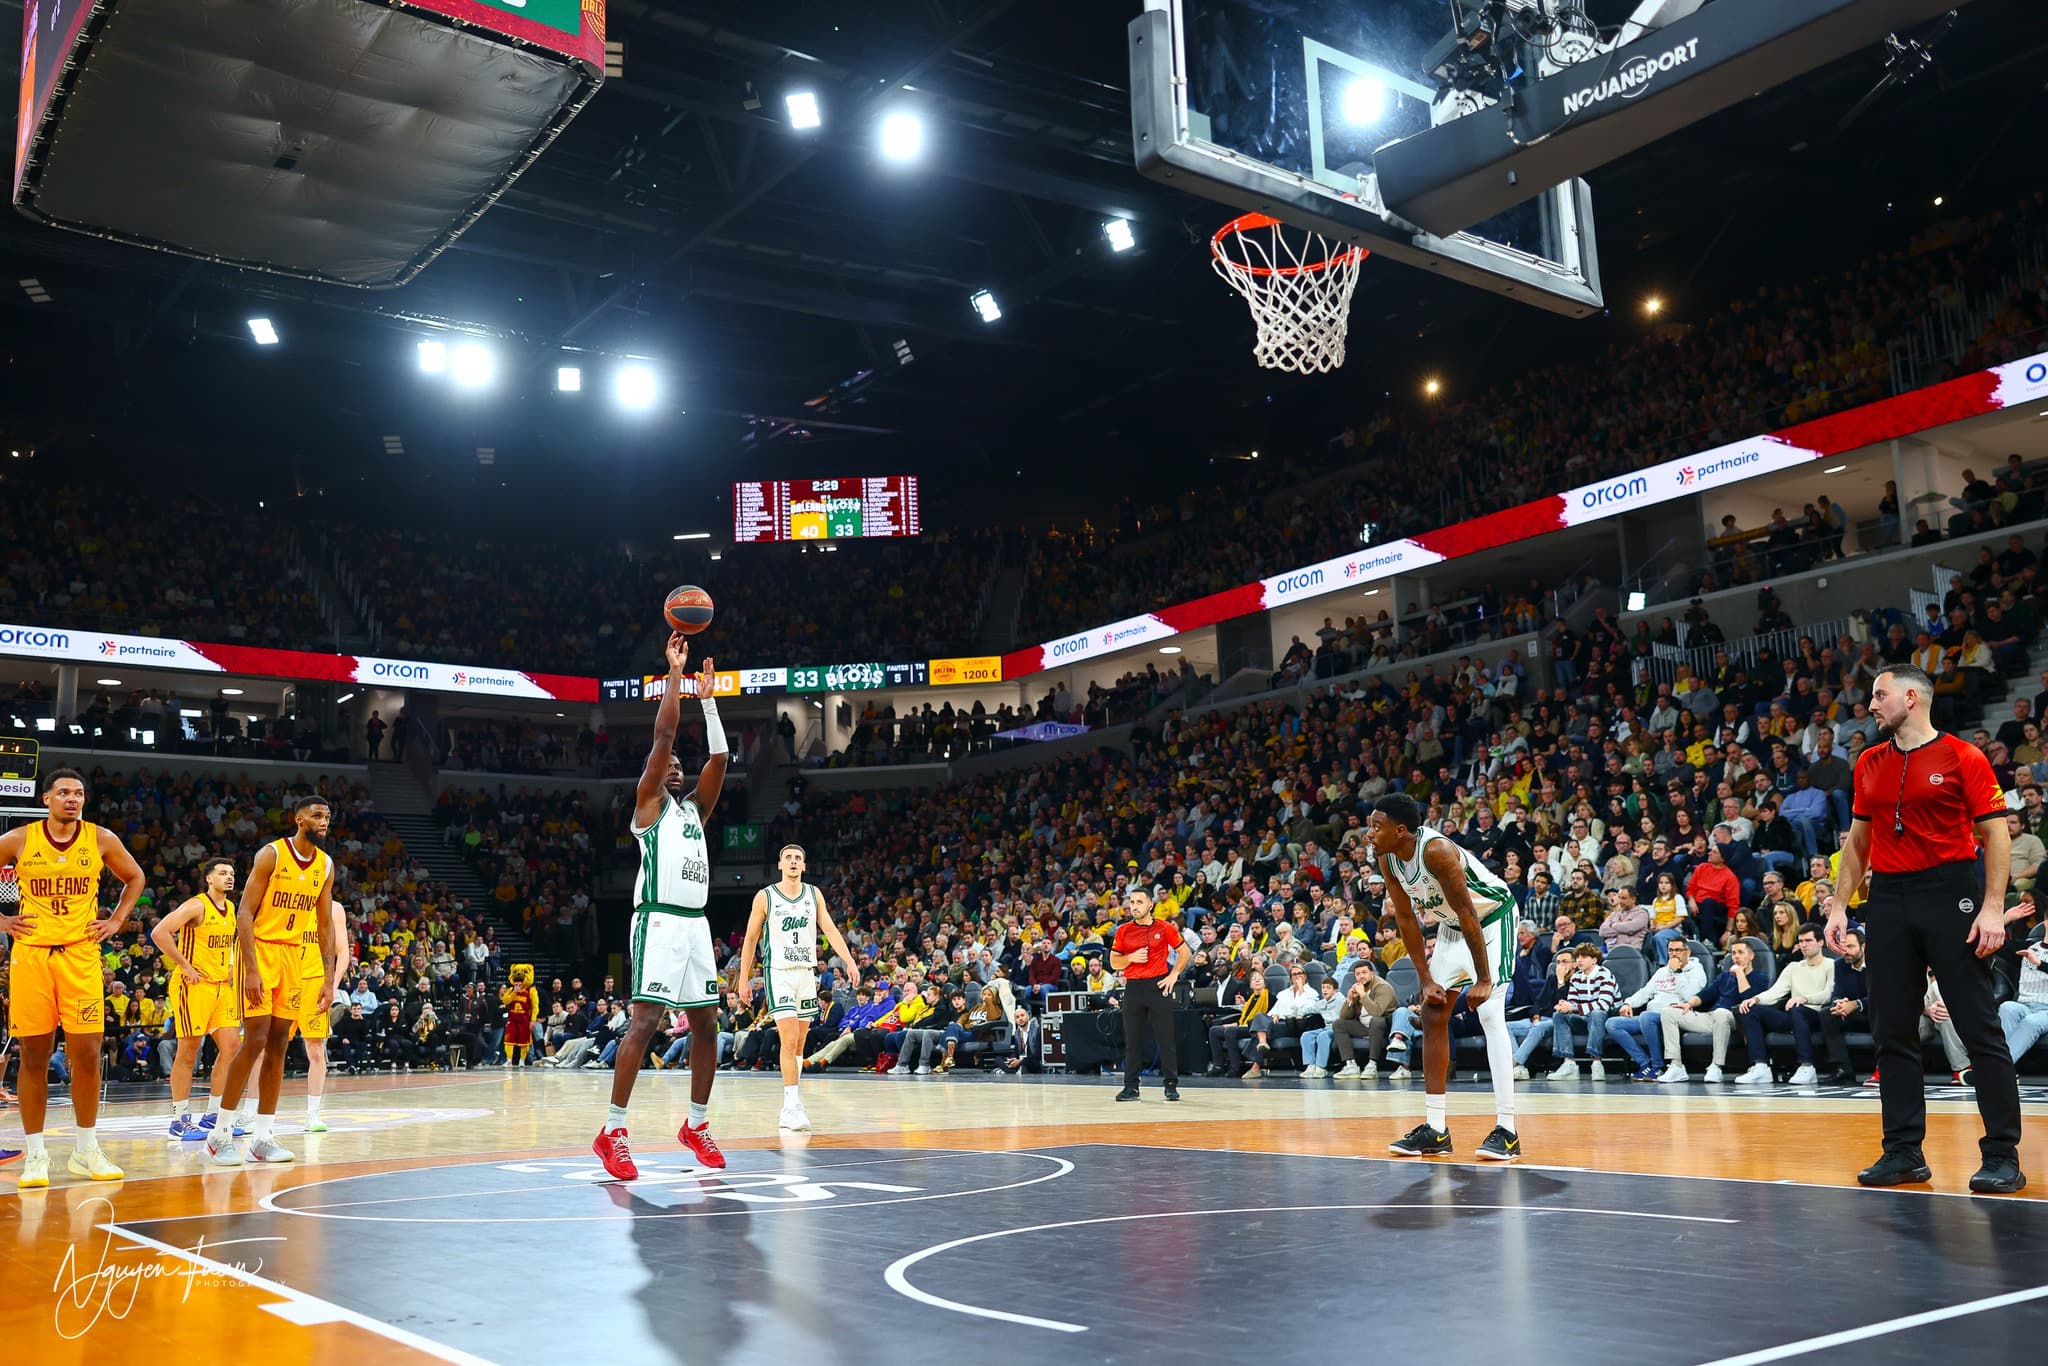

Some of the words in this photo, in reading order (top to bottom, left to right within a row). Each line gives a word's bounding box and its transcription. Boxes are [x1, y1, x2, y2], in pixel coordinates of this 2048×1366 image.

[1563, 37, 1699, 115] NOUANSPORT
[1582, 476, 1648, 508] orcom
[1697, 451, 1759, 480] partnaire
[800, 525, 819, 538] 40
[835, 524, 854, 537] 33
[1277, 568, 1324, 593] orcom
[1359, 552, 1403, 574] partnaire
[0, 629, 69, 648] orcom
[119, 644, 176, 658] partnaire
[1053, 636, 1088, 657] orcom
[1114, 625, 1147, 643] partnaire
[373, 663, 429, 680] orcom
[469, 675, 515, 687] partnaire
[750, 672, 777, 683] 2:29
[793, 671, 818, 688] 33
[825, 667, 884, 687] BLOIS
[894, 673, 902, 683] 5
[918, 672, 924, 682] 1
[963, 670, 988, 679] 1200
[992, 669, 998, 678] €
[609, 688, 617, 698] 5
[631, 687, 639, 697] 0
[30, 875, 90, 897] ORLÉANS
[51, 899, 70, 916] 95
[286, 913, 296, 931] 8
[781, 916, 809, 932] Blois
[792, 931, 799, 945] 3
